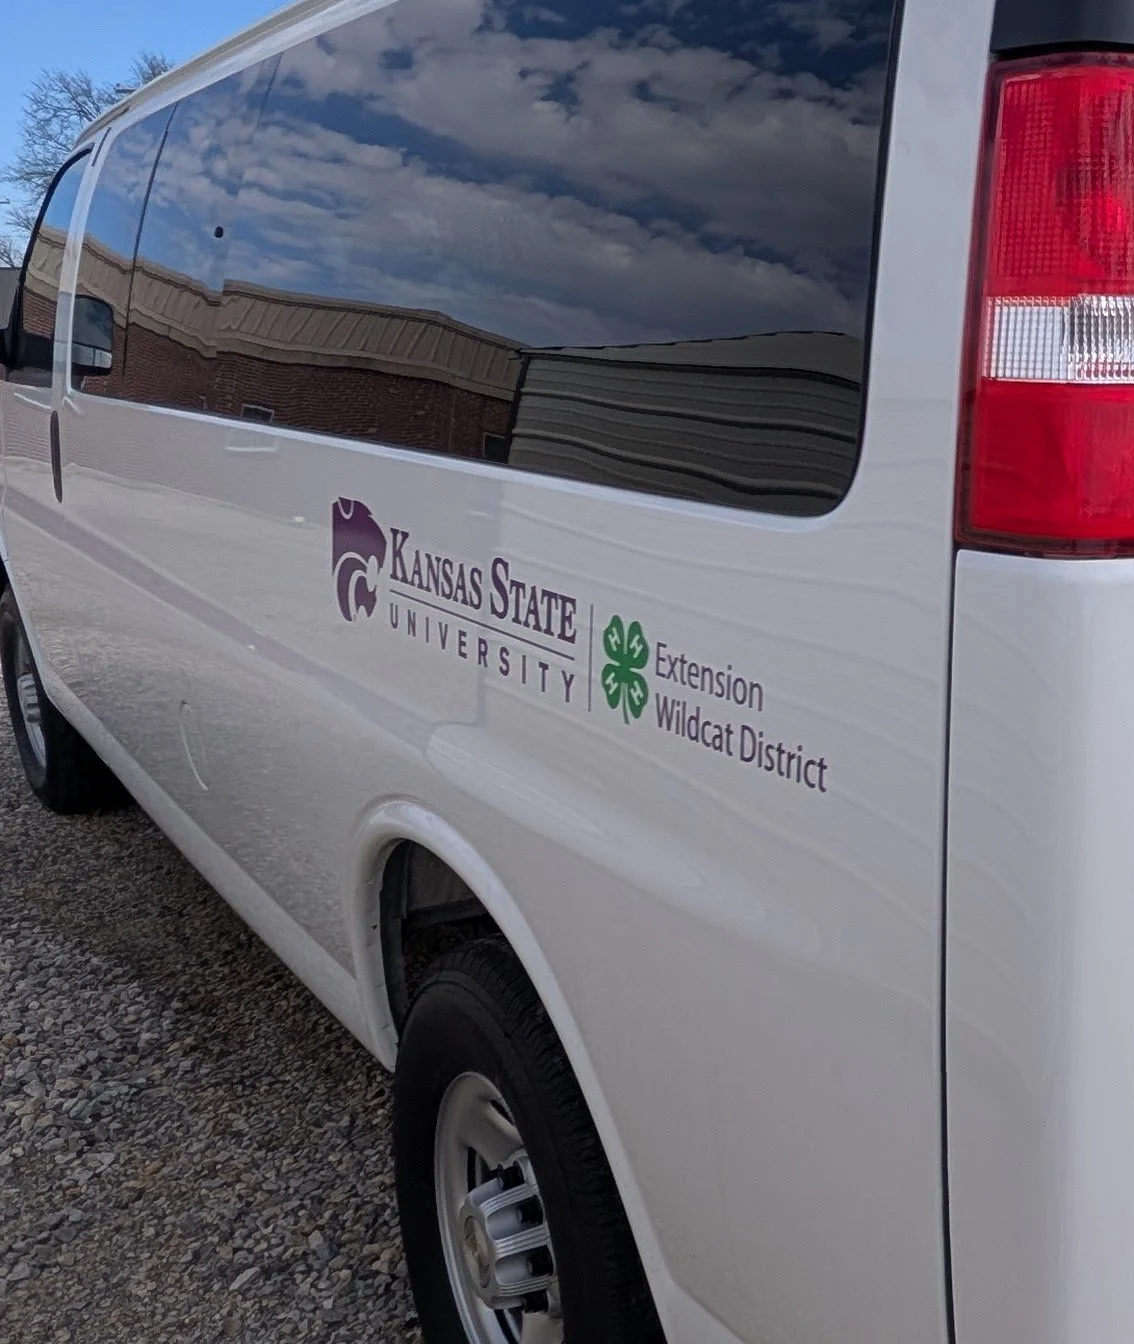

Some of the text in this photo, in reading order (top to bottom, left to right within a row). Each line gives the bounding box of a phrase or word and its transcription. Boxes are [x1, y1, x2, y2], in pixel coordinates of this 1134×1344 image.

[390, 527, 577, 644] KANSAS STATE
[389, 602, 575, 703] UNIVERSITY
[655, 641, 763, 712] Extension
[655, 692, 828, 793] Wildcat District
